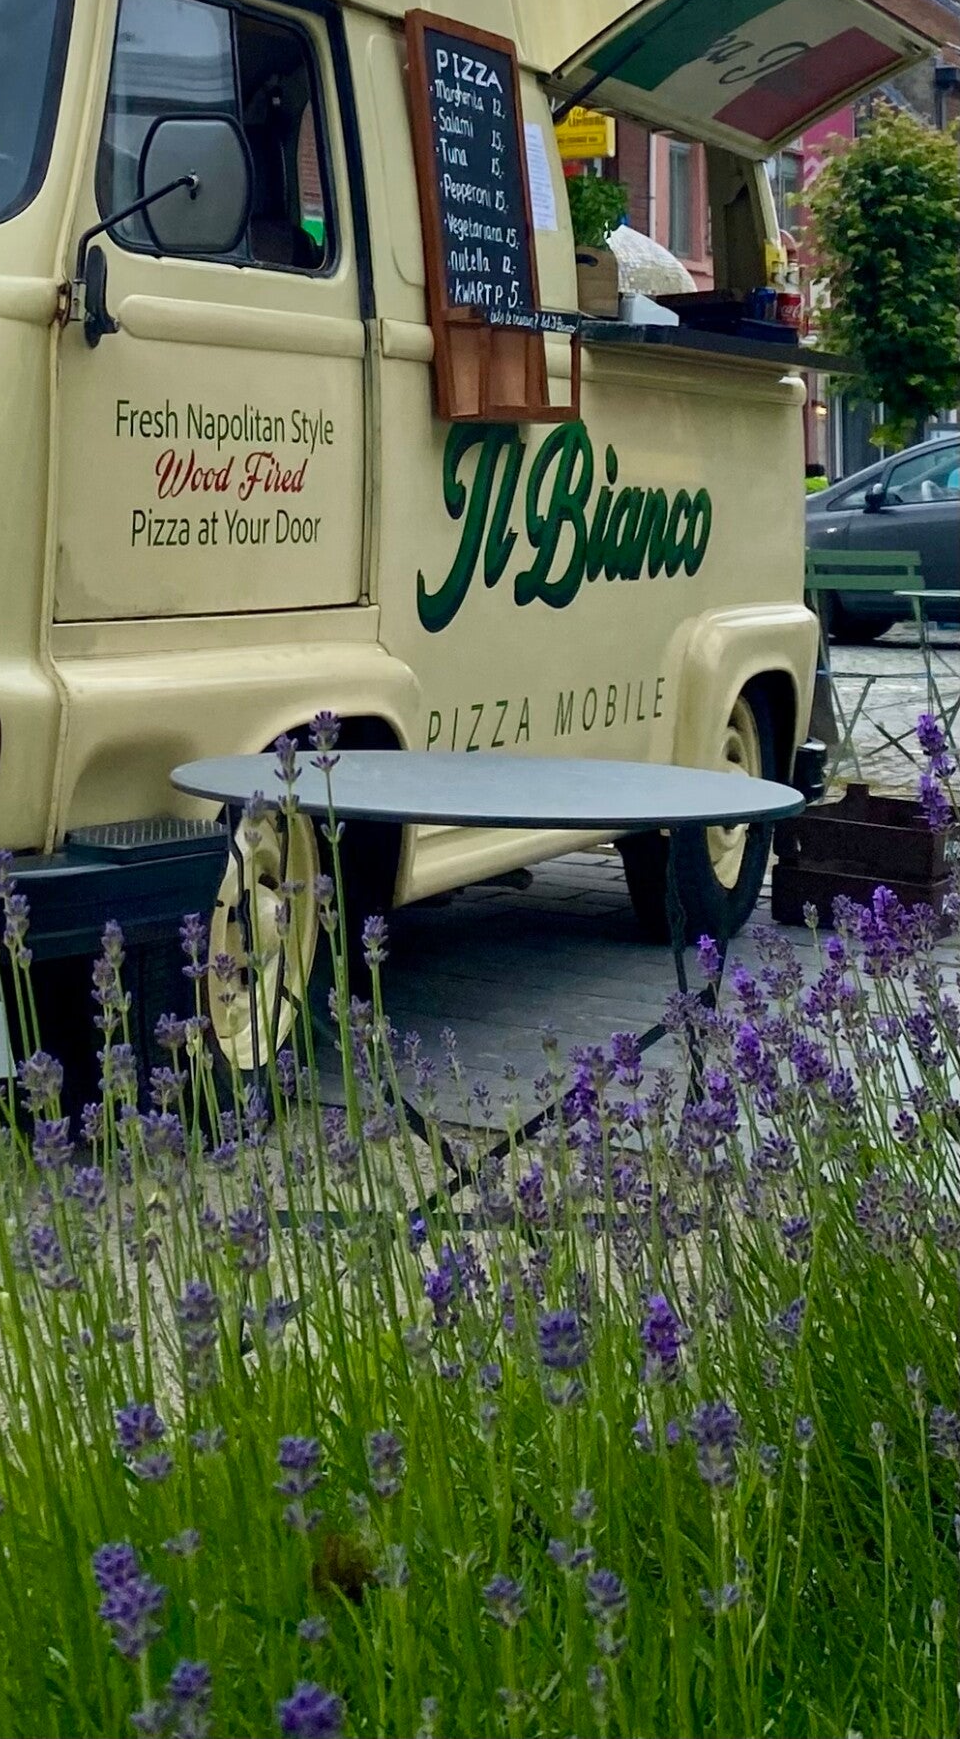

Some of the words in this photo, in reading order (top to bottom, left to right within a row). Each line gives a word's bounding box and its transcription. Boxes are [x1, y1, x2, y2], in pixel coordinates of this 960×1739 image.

[436, 48, 503, 94] PIZZA
[439, 106, 474, 139] Salami
[440, 137, 468, 166] Tuna
[443, 173, 491, 208] Pepperoni
[116, 399, 178, 439] Fresh
[187, 403, 285, 451] Napolitan
[291, 409, 334, 454] Style
[155, 449, 235, 500] Wood
[238, 451, 309, 501] Fired
[131, 508, 189, 547] Pizza
[198, 511, 218, 545] at
[224, 509, 270, 545] Your
[275, 509, 321, 544] Door
[514, 418, 712, 609] Bianco
[426, 696, 530, 753] PIZZA
[554, 677, 666, 737] MOBILE
